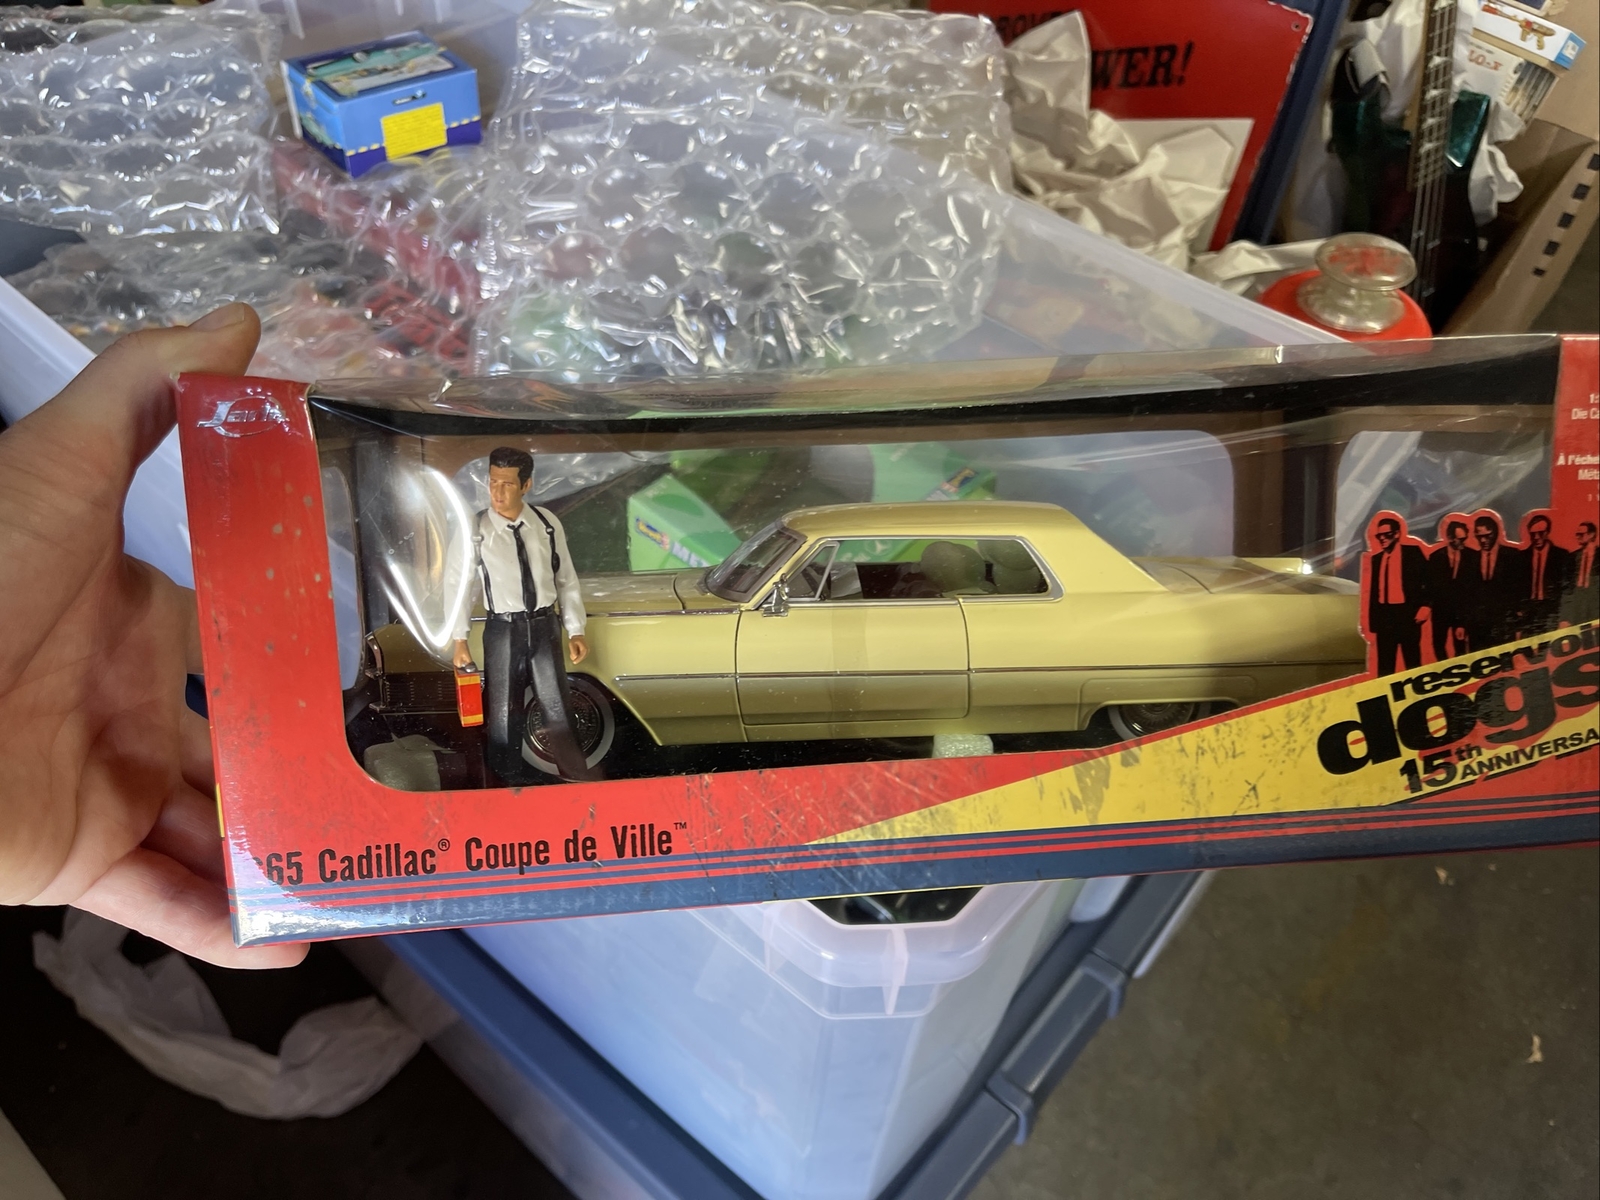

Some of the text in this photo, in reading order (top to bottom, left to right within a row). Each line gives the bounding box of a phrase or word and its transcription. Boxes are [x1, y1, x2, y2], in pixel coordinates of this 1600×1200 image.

[1571, 408, 1588, 420] Die
[1317, 651, 1600, 776] dogs
[1399, 743, 1483, 794] 15th
[464, 836, 551, 876] Coupe
[564, 829, 597, 864] de
